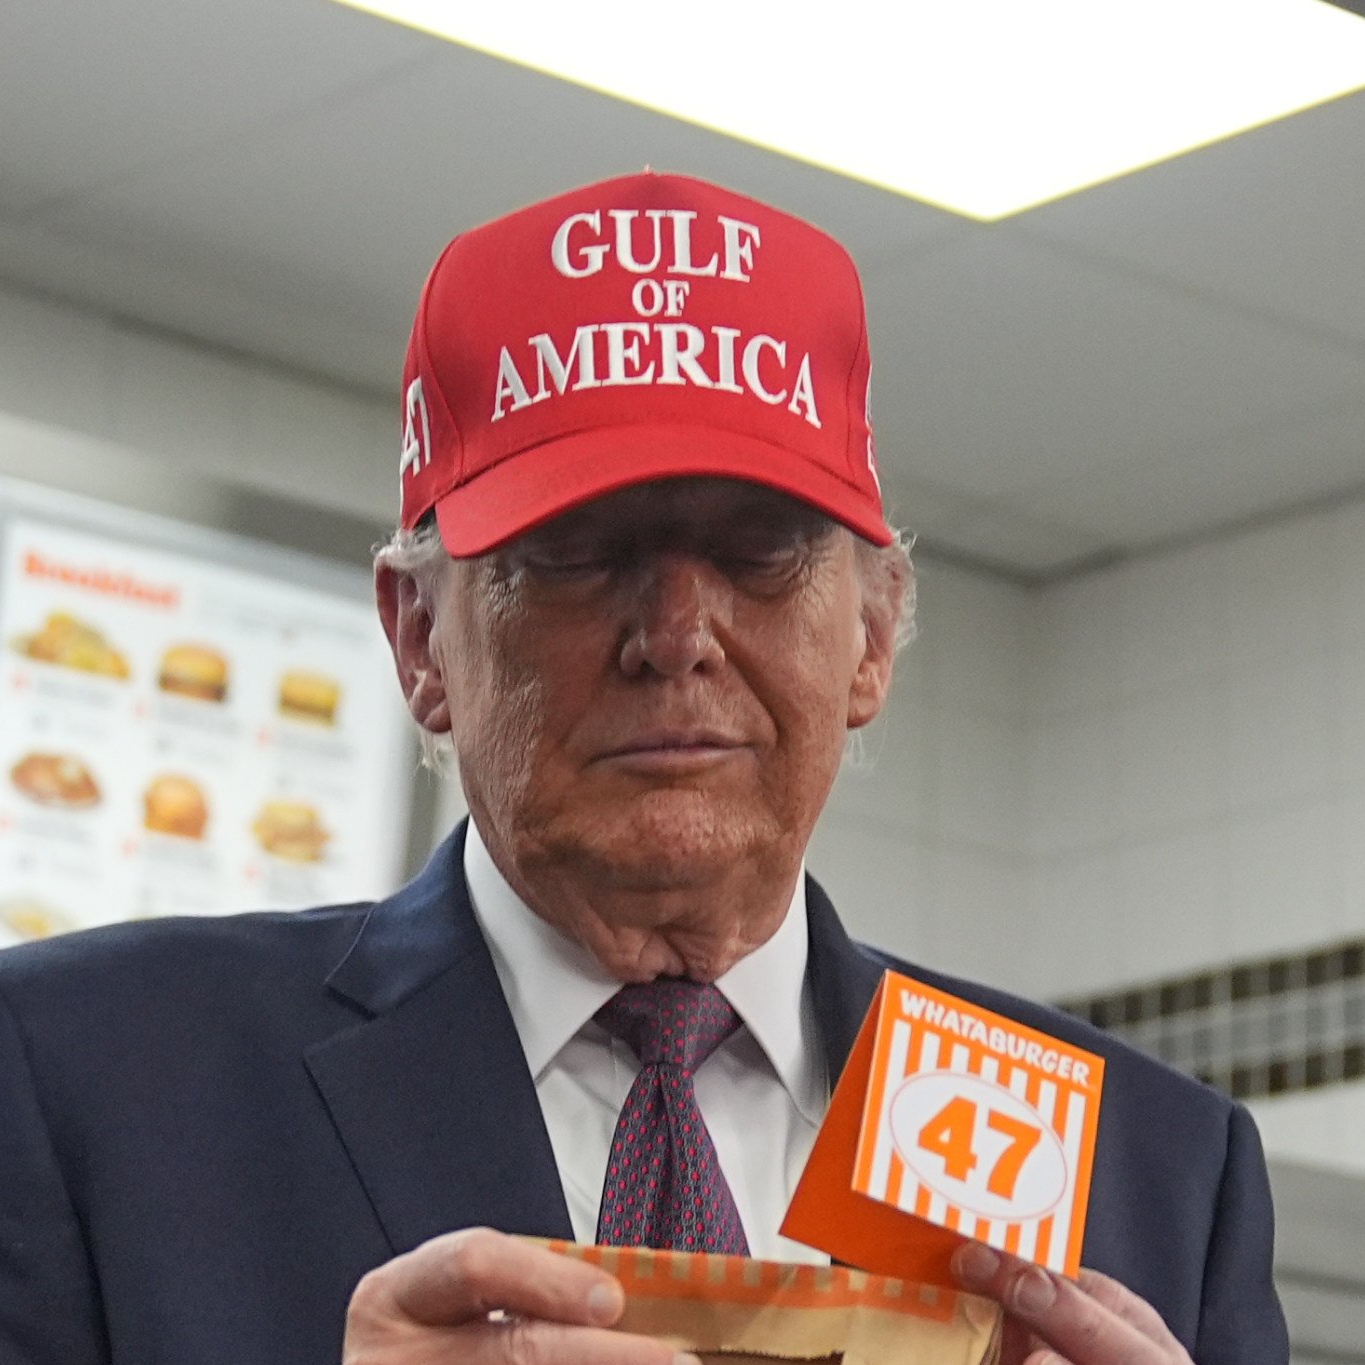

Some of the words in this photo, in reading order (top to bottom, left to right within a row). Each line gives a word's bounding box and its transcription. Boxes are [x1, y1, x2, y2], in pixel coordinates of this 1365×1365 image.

[551, 208, 761, 283] GULF
[632, 278, 690, 317] OF
[490, 322, 822, 429] AMERICA
[899, 988, 1091, 1087] WHATABURGER
[917, 1095, 1042, 1201] 47
